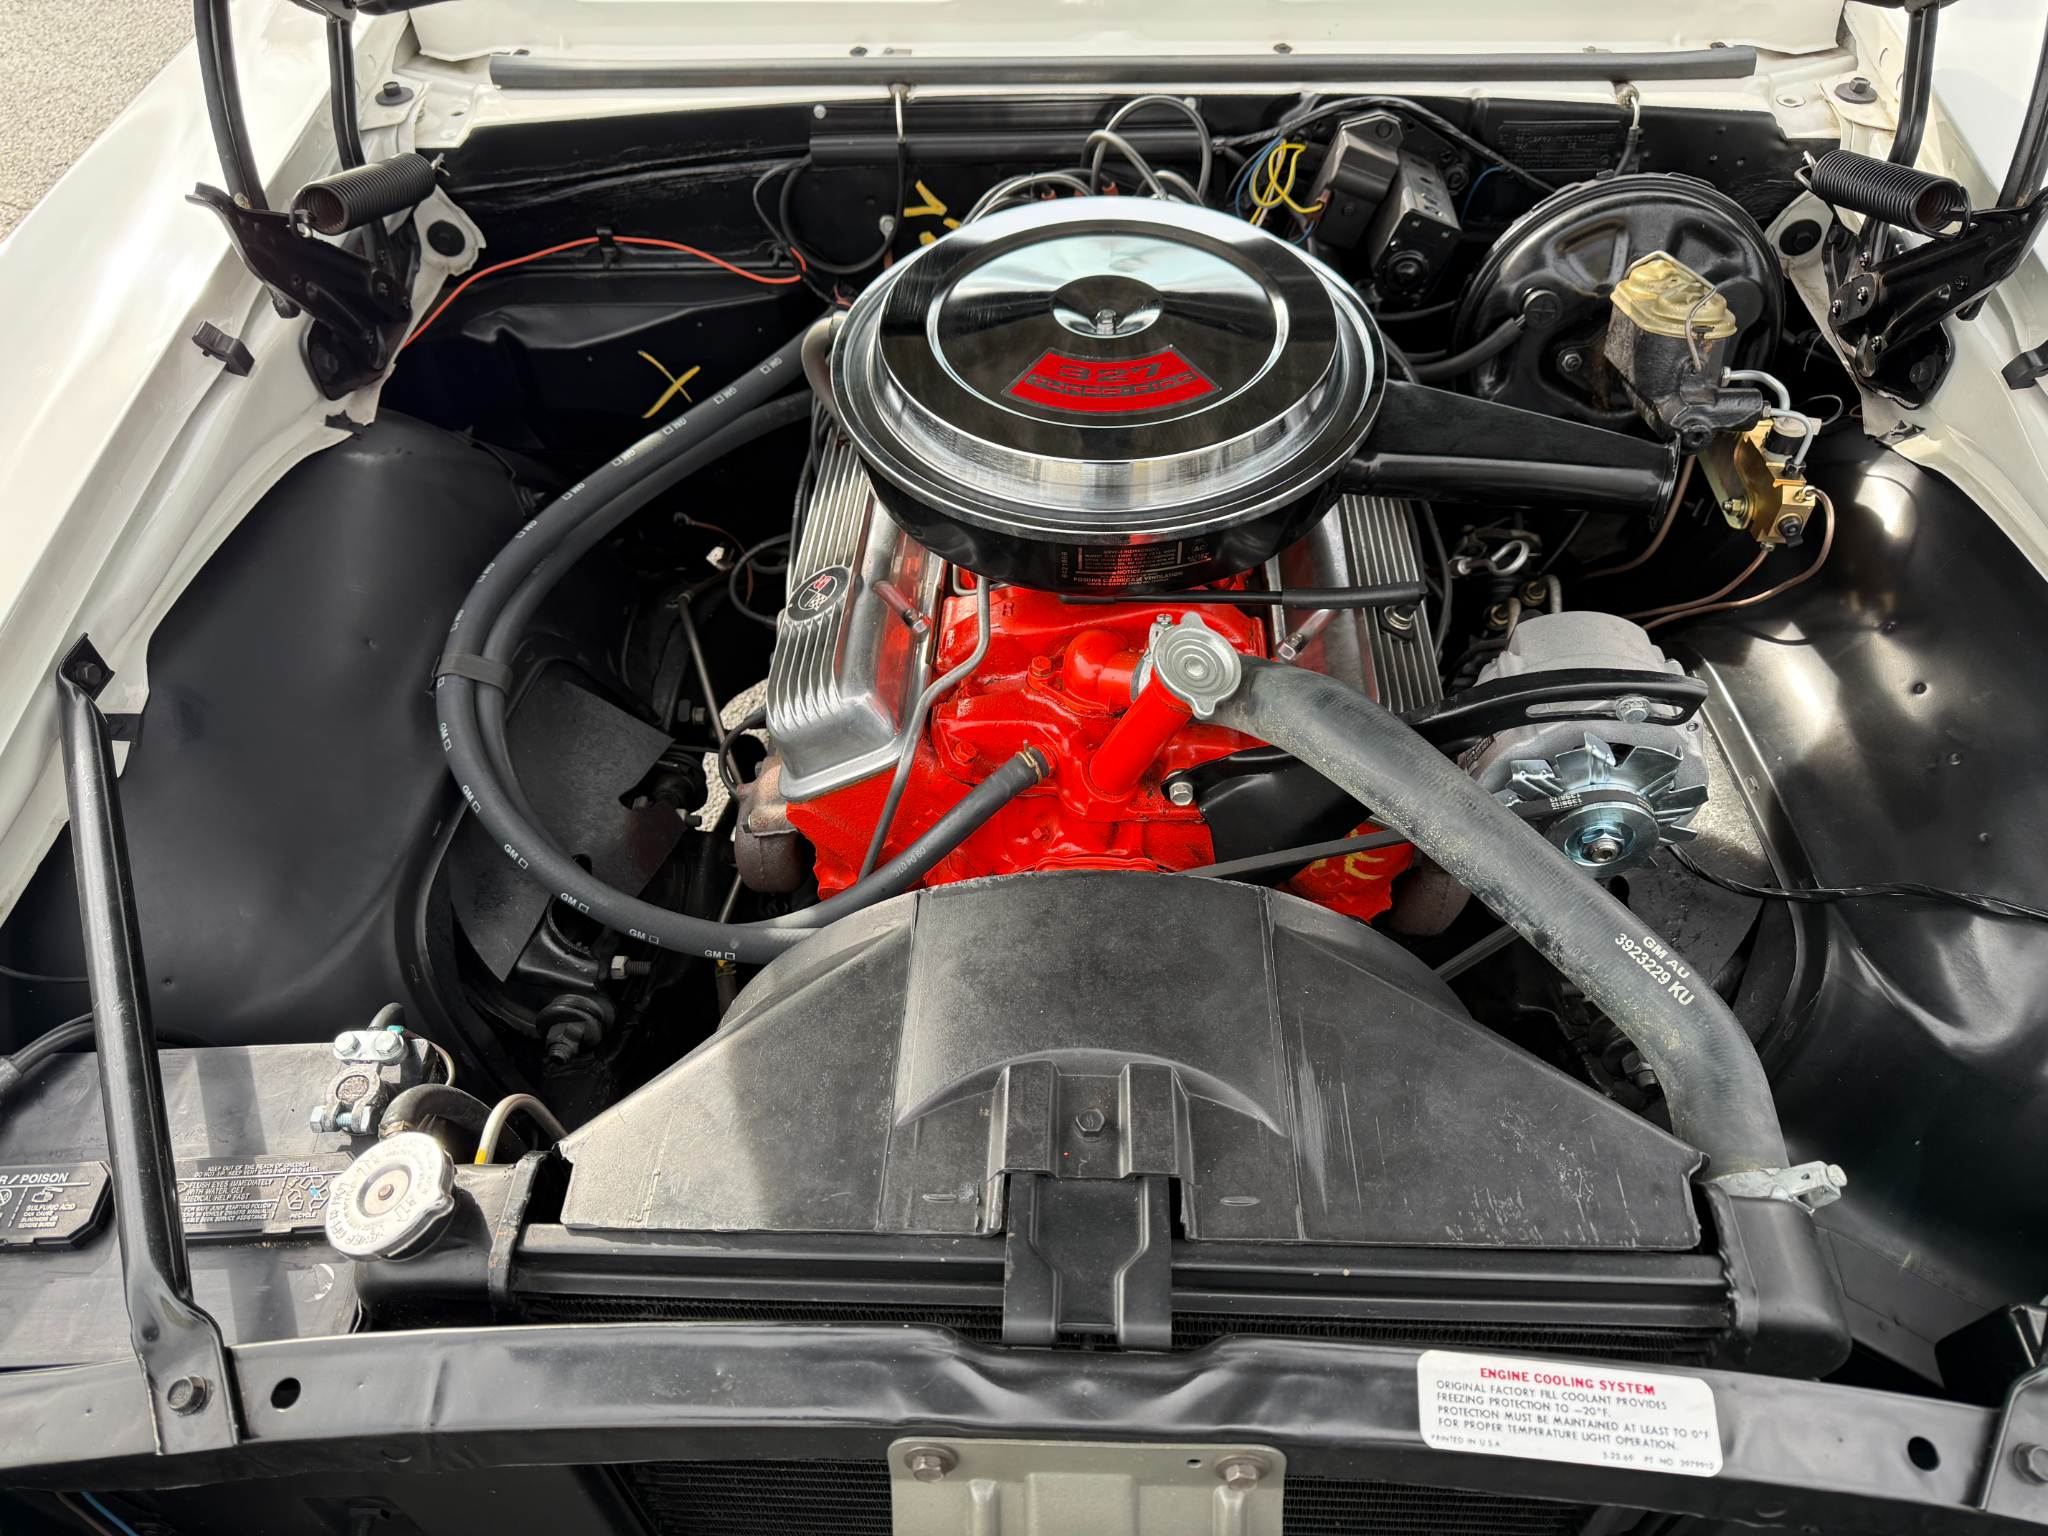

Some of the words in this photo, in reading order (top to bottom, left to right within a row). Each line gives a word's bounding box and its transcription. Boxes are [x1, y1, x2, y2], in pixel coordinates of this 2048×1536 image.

[1058, 362, 1162, 382] 327
[1032, 373, 1192, 395] TURBO-FIRE
[1144, 571, 1184, 581] VENTILATION
[503, 843, 519, 861] GM
[560, 892, 577, 907] GM
[628, 928, 646, 941] GM
[704, 949, 721, 960] GM
[1642, 936, 1668, 959] GM
[1665, 959, 1691, 979] AU
[1614, 933, 1672, 985] 3923229
[1667, 980, 1695, 1006] KU
[19, 1172, 70, 1184] POISON
[189, 1181, 211, 1189] FLUSH
[212, 1180, 229, 1188] EYES
[230, 1179, 274, 1187] IMMEDIATELY
[183, 1195, 212, 1203] MEDICAL
[214, 1194, 232, 1202] HELP
[232, 1193, 251, 1201] FAST
[187, 1188, 205, 1196] WITH
[26, 1204, 59, 1212] SULFURIC
[59, 1203, 76, 1211] ACID
[290, 1212, 318, 1220] RECYCLE
[1480, 1367, 1530, 1383] ENGINE
[1534, 1373, 1594, 1389] COOLING
[1599, 1380, 1656, 1396] SYSTEM
[1436, 1380, 1486, 1394] ORIGINAL
[1490, 1385, 1535, 1398] FACTORY
[1540, 1389, 1558, 1400] FILL
[1561, 1392, 1612, 1405] COOLANT
[1616, 1397, 1667, 1410] PROVIDES
[1437, 1392, 1485, 1405] FREEZING
[1489, 1397, 1551, 1412] PROTECTION
[1555, 1403, 1569, 1413] TO
[1437, 1405, 1499, 1419] PROTECTION
[1505, 1411, 1532, 1423] MUST
[1537, 1415, 1549, 1424] BE
[1553, 1416, 1619, 1431] MAINTAINED
[1624, 1423, 1636, 1433] AT
[1640, 1425, 1669, 1437] LEAST
[1673, 1428, 1688, 1438] TO
[1438, 1418, 1459, 1428] FOR
[1464, 1420, 1503, 1432] PROPER
[1508, 1424, 1578, 1441] TEMPERATURE
[1582, 1432, 1611, 1444] LIGHT
[1431, 1434, 1464, 1445] PRINTED
[1468, 1436, 1476, 1445] IN
